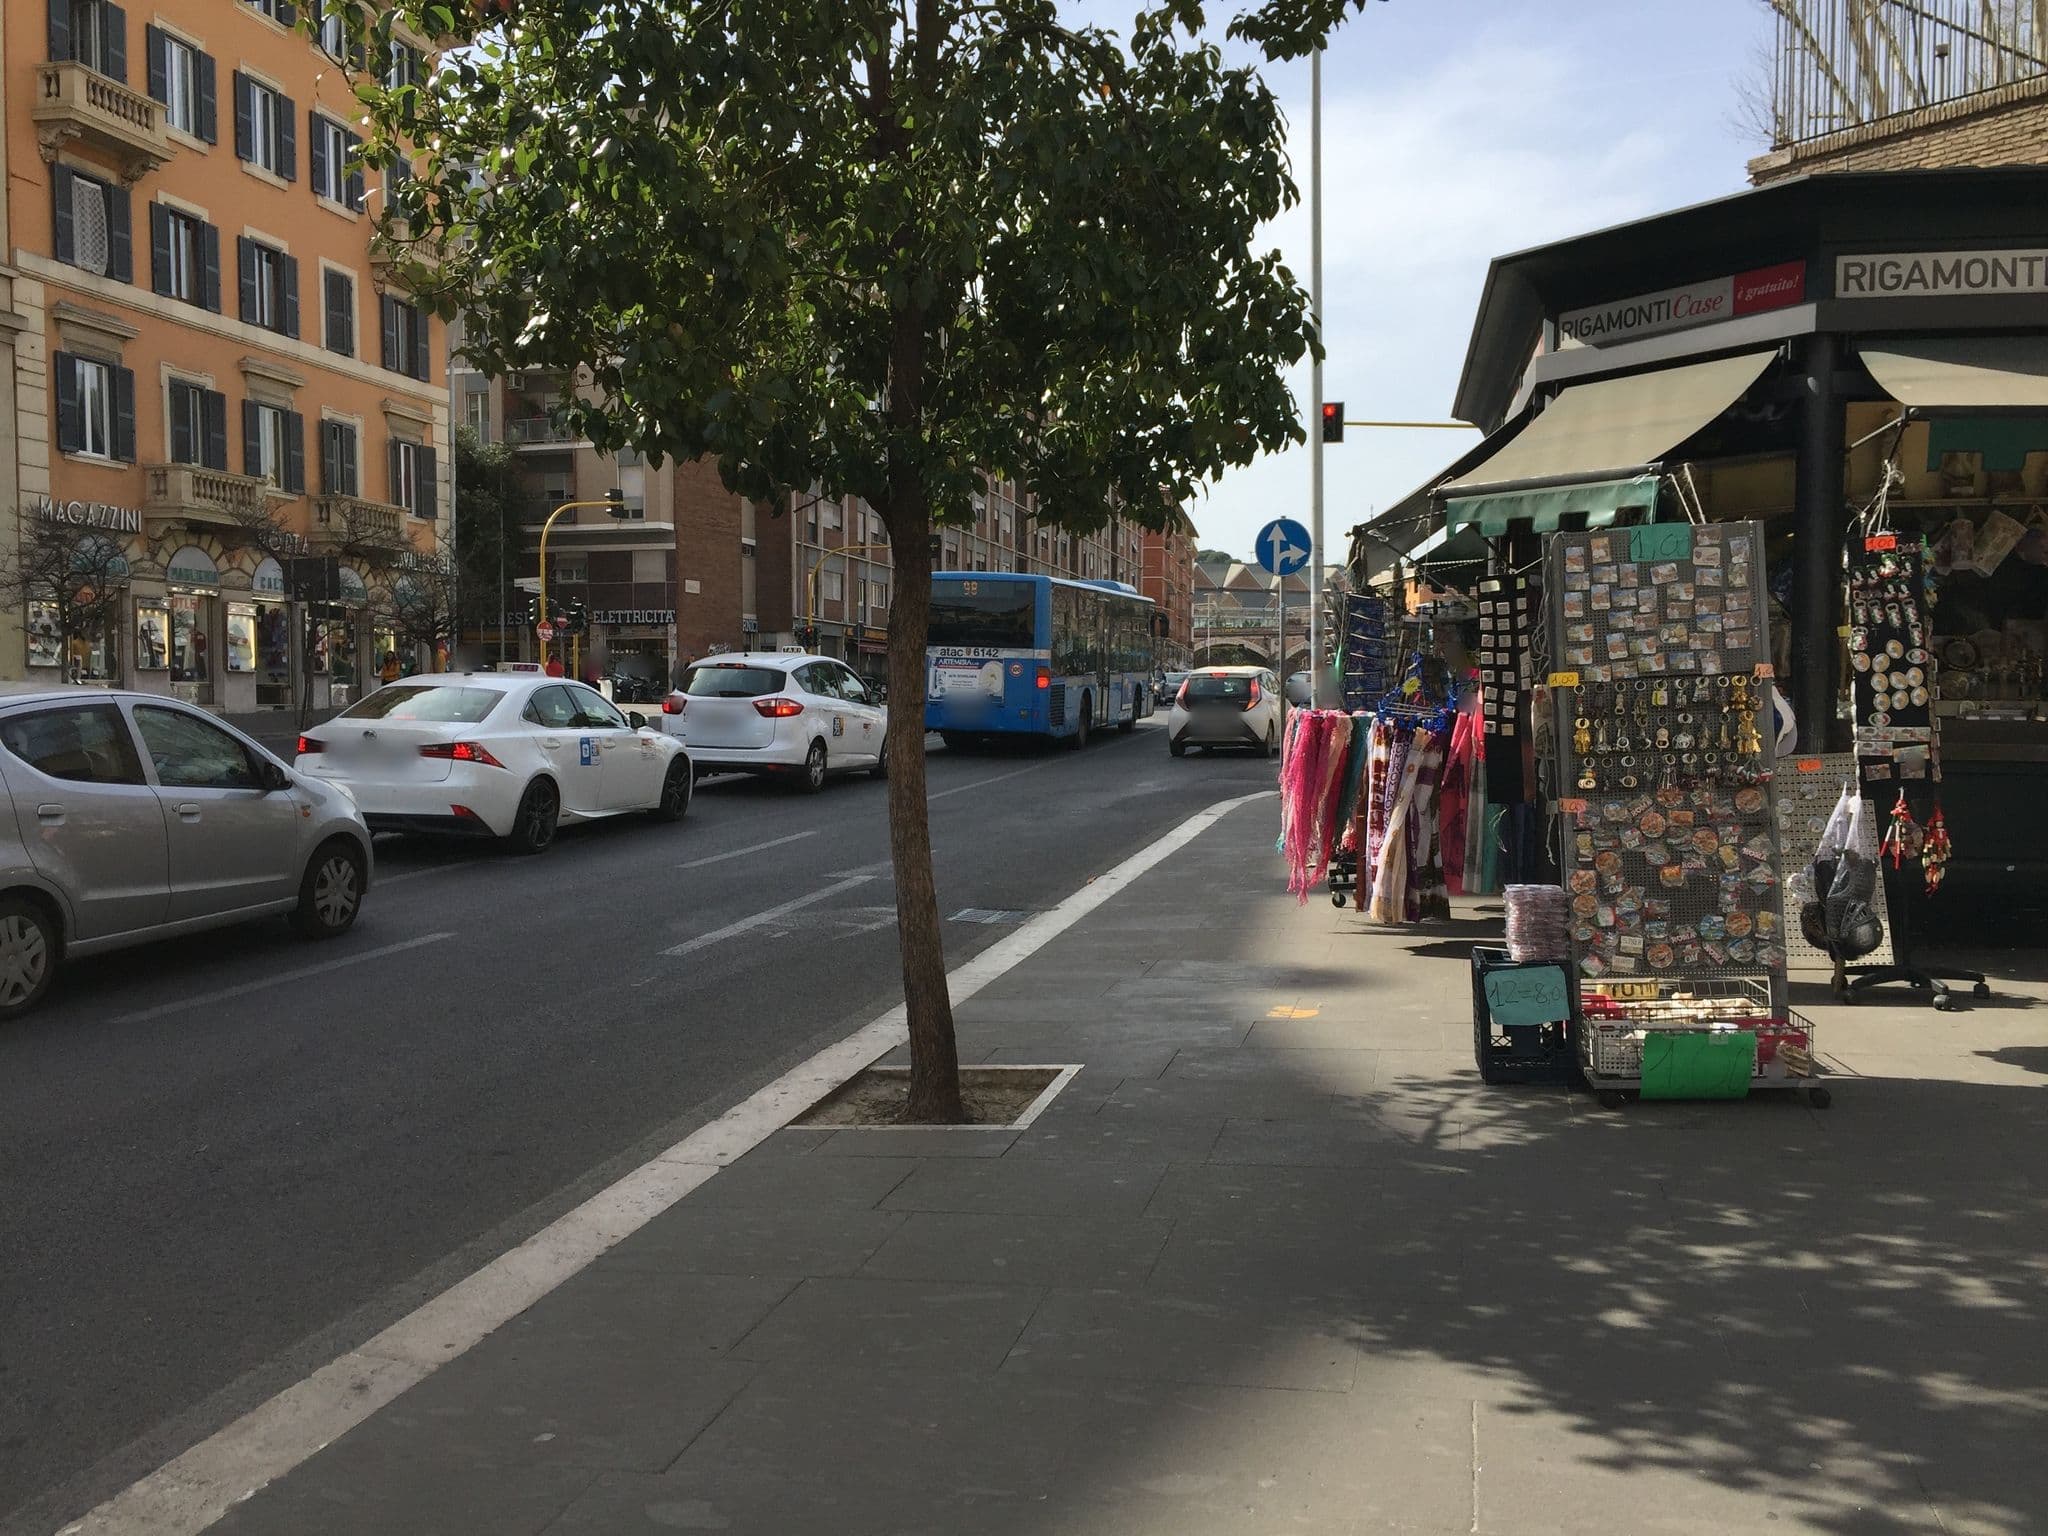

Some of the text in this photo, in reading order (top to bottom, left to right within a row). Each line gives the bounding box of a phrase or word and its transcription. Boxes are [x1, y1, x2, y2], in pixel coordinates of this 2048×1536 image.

[1745, 274, 1799, 302] gratuito!
[1561, 293, 1723, 341] RIGAMONTI Case
[39, 495, 142, 533] MAGAZZINI
[939, 647, 999, 658] atac 6142
